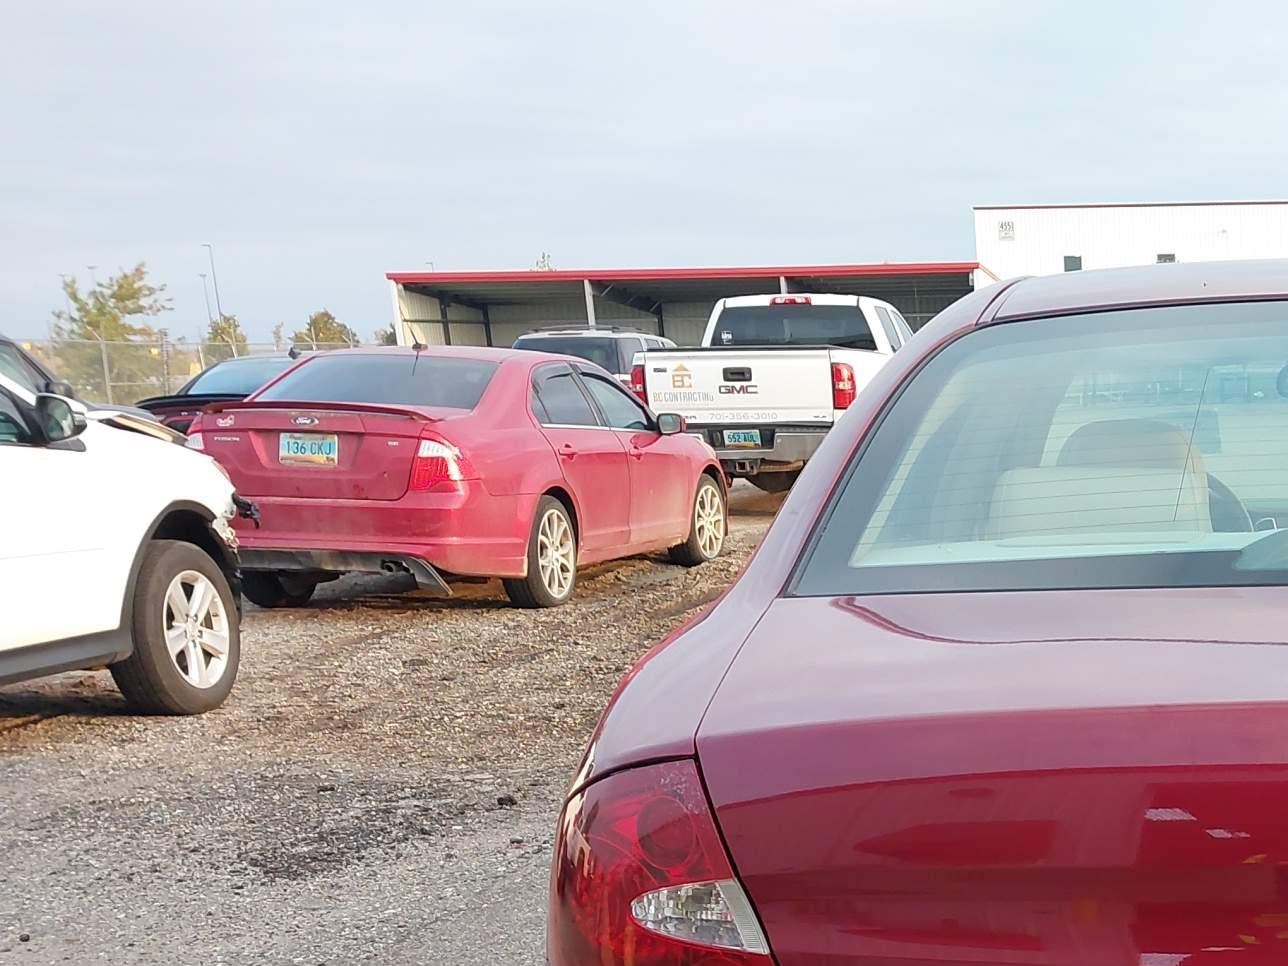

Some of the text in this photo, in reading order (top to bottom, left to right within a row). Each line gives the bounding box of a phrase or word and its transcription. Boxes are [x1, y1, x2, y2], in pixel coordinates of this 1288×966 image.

[718, 384, 759, 394] GMC
[664, 391, 715, 402] CONTRACTING
[286, 440, 332, 456] 136 CKJ
